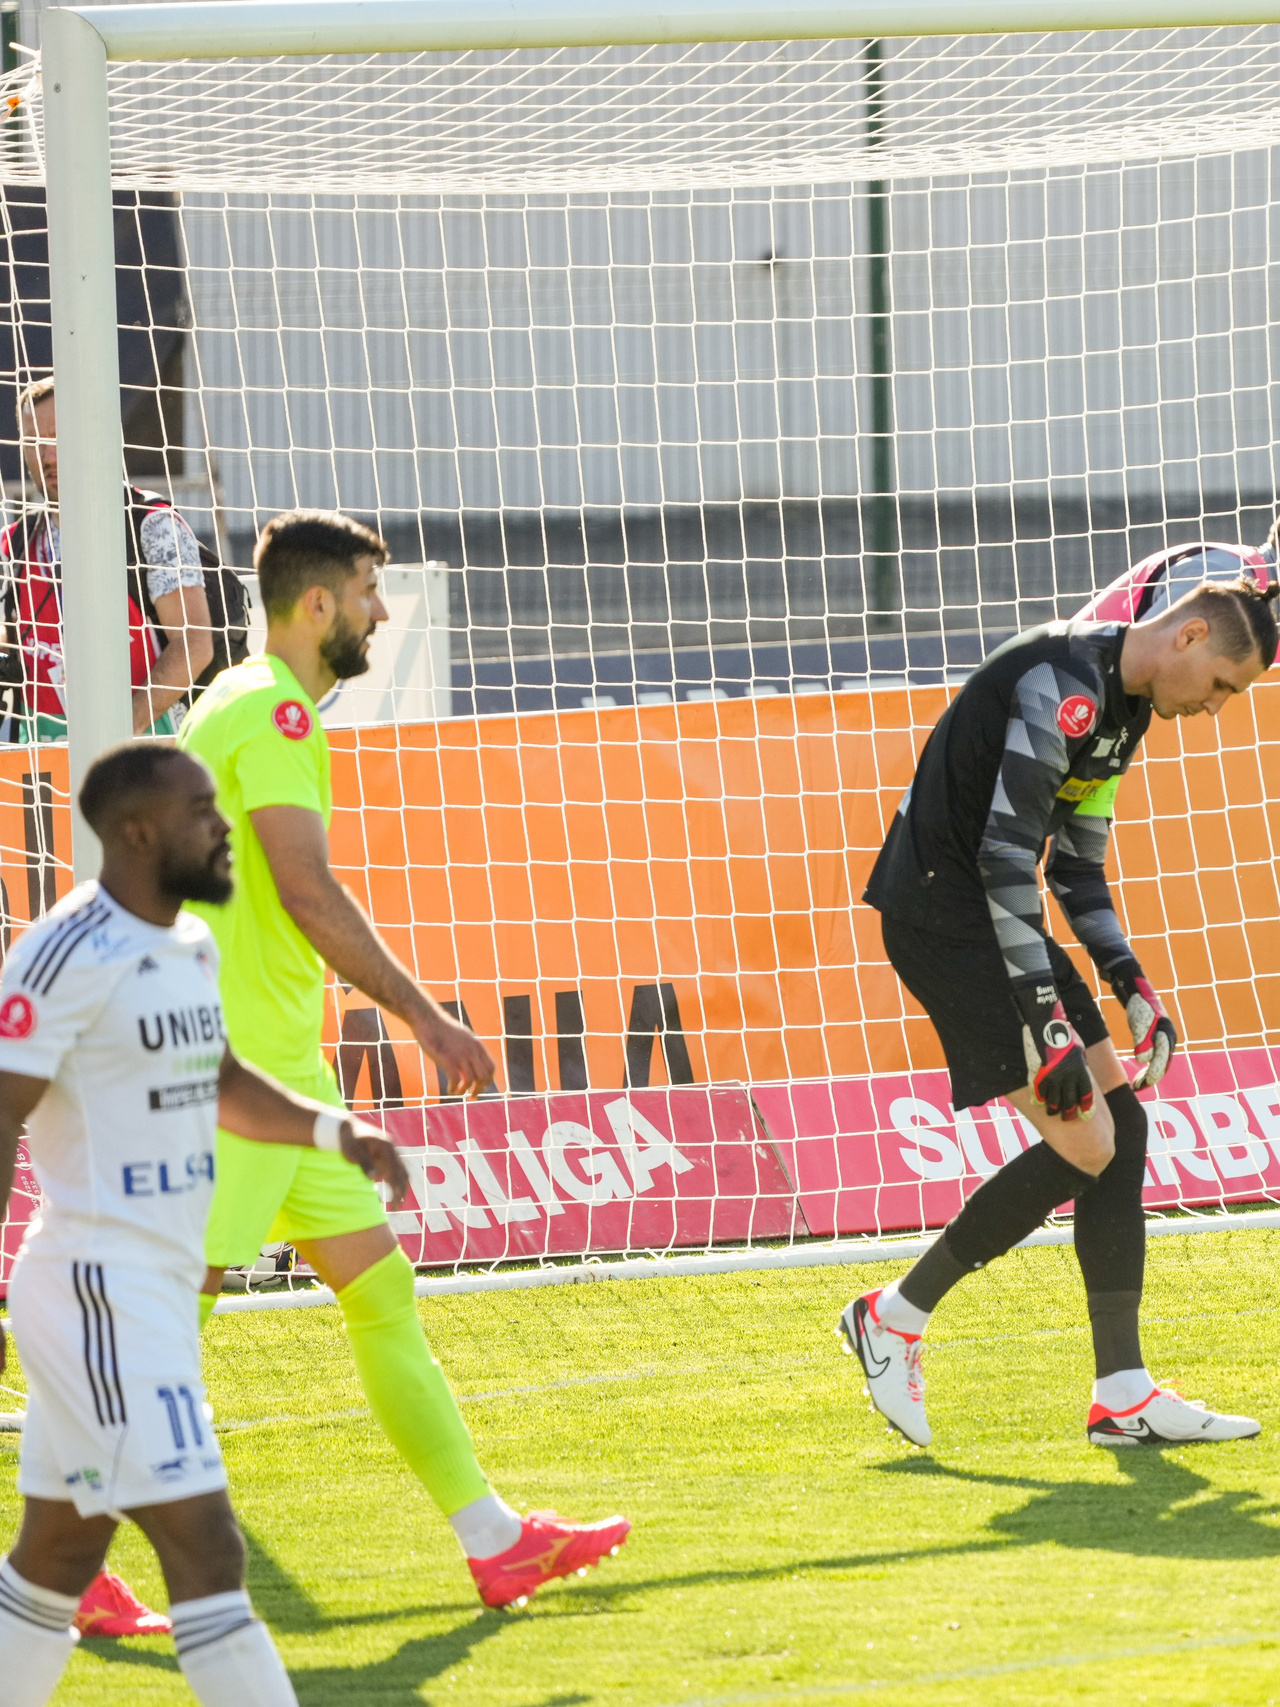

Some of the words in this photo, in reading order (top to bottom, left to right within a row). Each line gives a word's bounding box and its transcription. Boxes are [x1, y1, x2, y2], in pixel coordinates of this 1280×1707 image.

[138, 1003, 225, 1052] UNIBE
[122, 1152, 215, 1198] ELSA
[378, 1097, 695, 1235] RLIGA
[156, 1384, 204, 1449] 11
